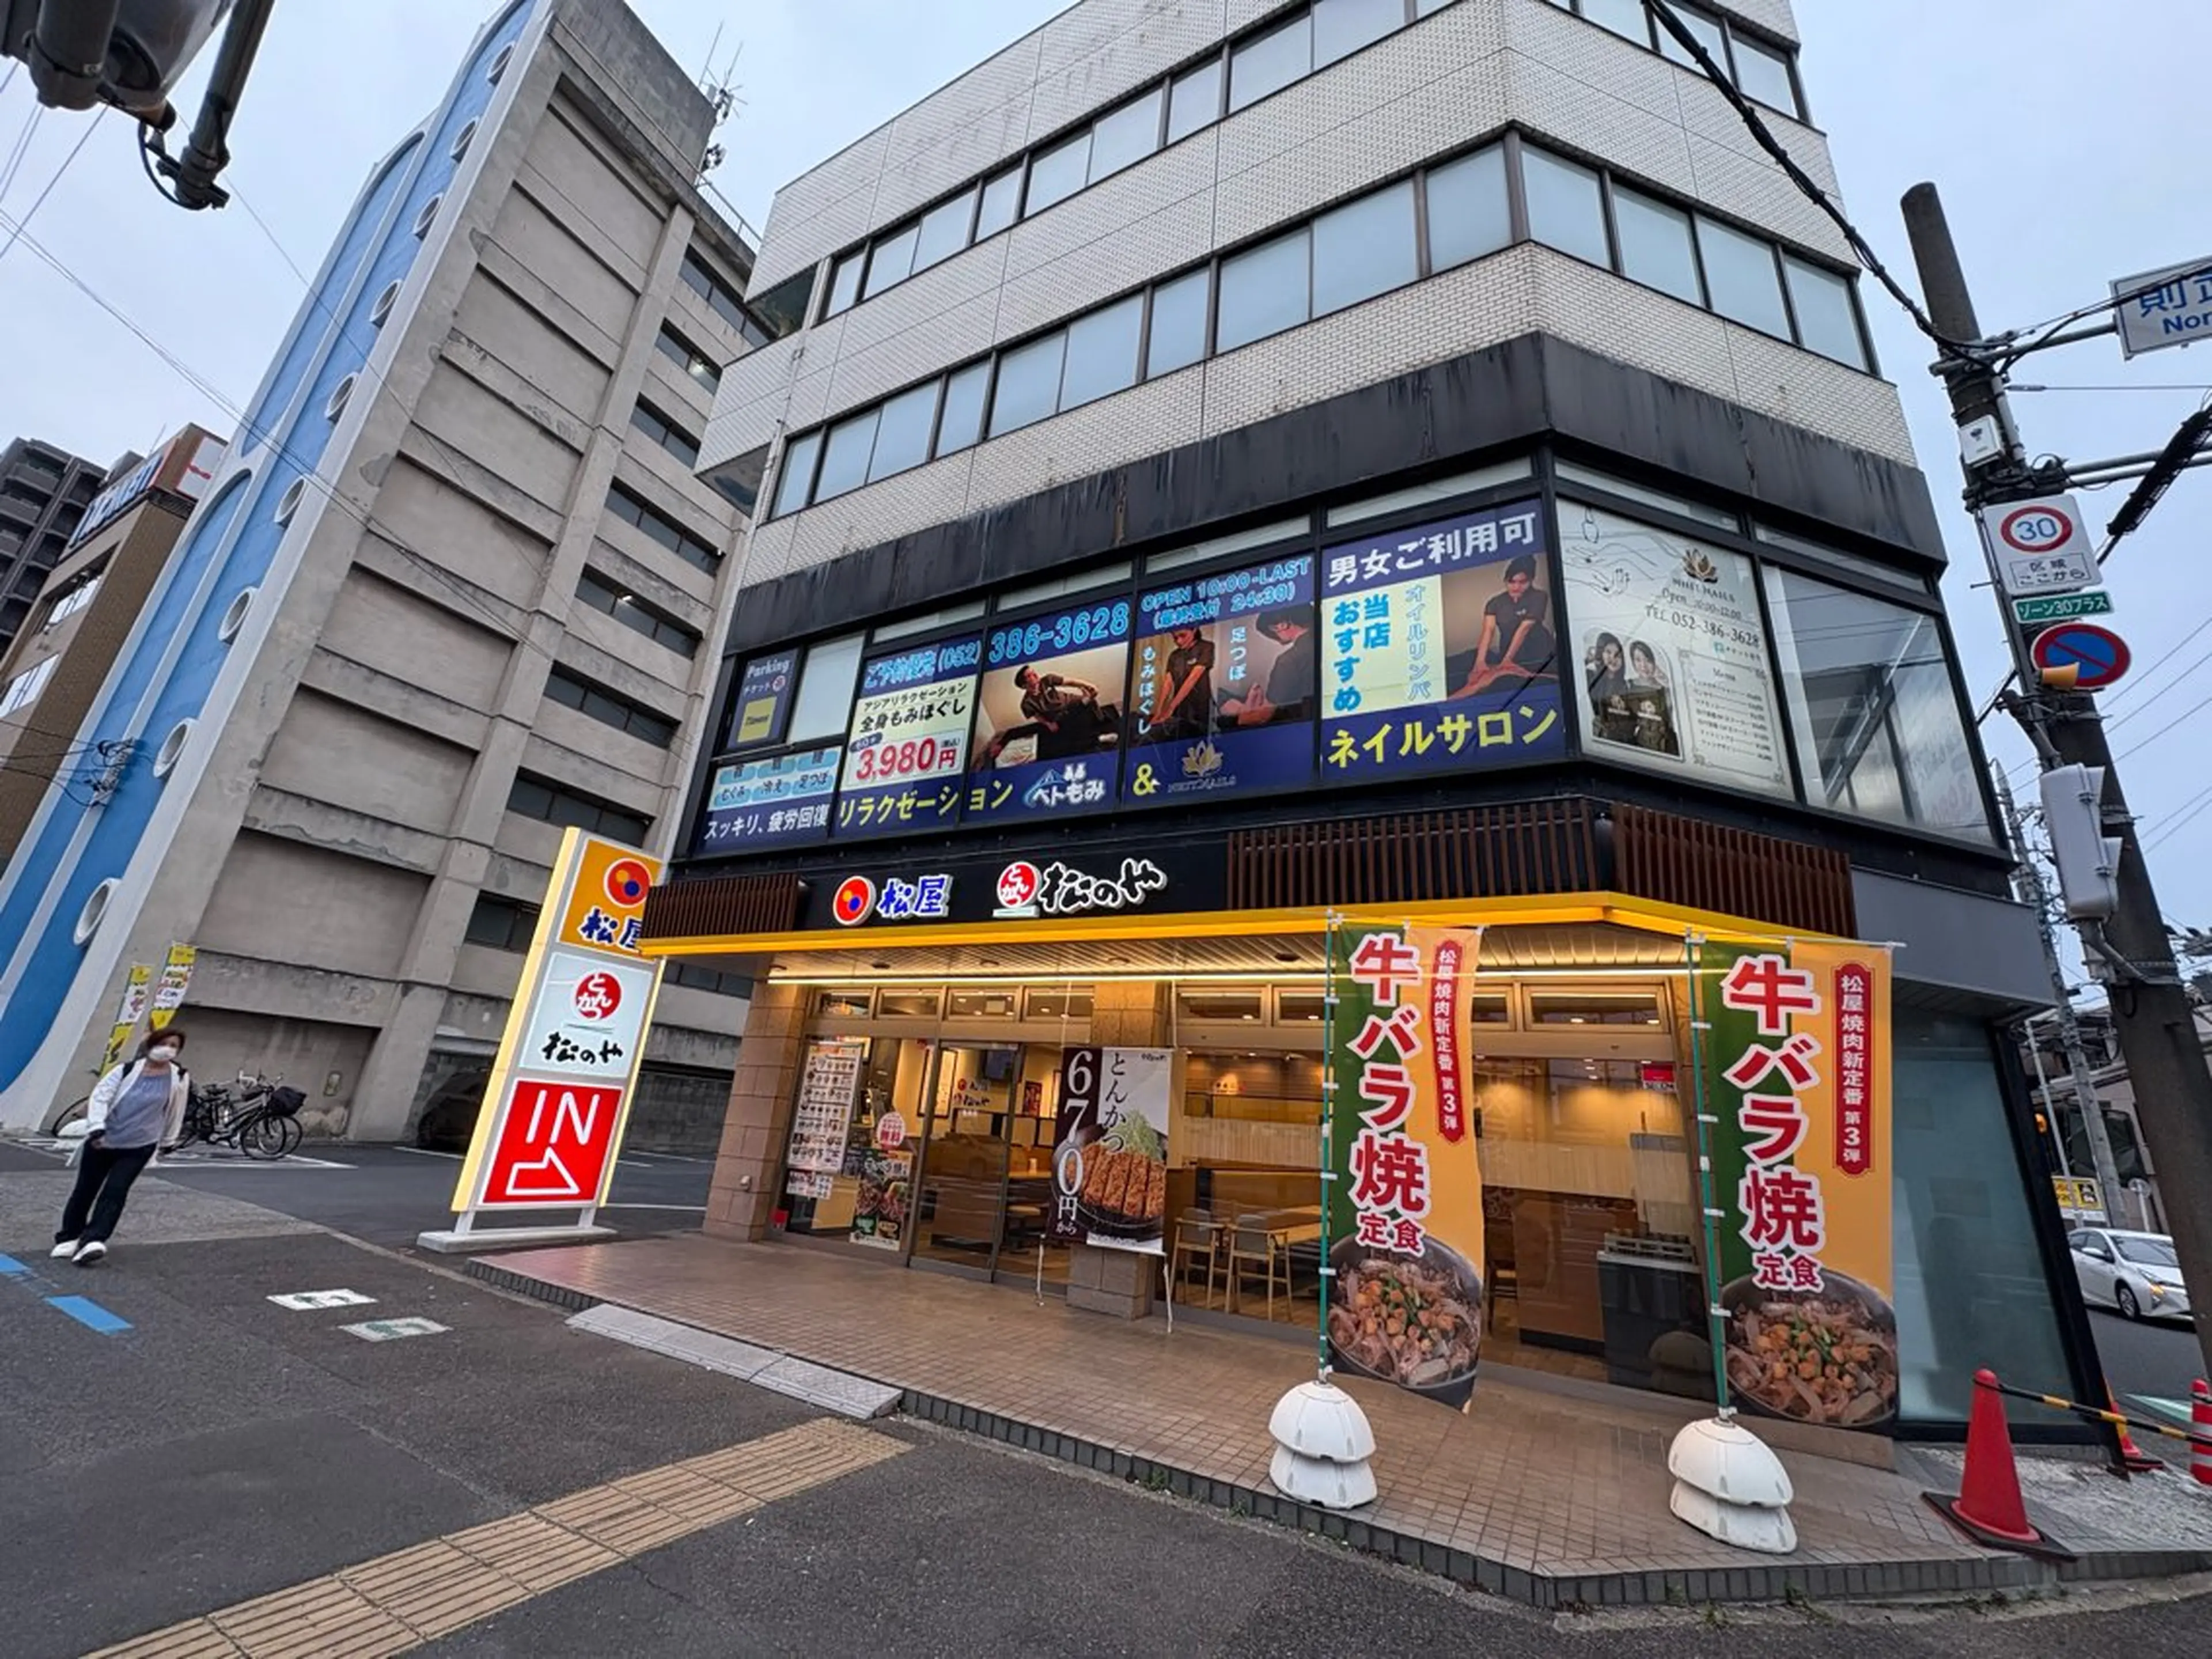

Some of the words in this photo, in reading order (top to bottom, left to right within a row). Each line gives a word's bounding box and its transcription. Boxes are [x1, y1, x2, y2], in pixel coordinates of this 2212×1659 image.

[1328, 512, 1536, 587] 男女ご利用可
[2017, 517, 2058, 540] 30
[1141, 586, 1192, 612] OPEN
[2019, 568, 2085, 585] ここから
[988, 602, 1130, 664] 386-3628
[1362, 593, 1391, 650] 当店
[747, 658, 790, 679] Parking
[1228, 626, 1247, 681] 足つぼ
[1333, 601, 1362, 713] おすすめ
[1138, 646, 1156, 735] もみほぐし
[859, 699, 966, 733] 全身もみほぐし
[1327, 706, 1557, 768] ネイルサロン
[839, 779, 1014, 828] リラクゼーション
[1032, 779, 1105, 806] ベトもみ
[1132, 763, 1154, 796] &
[877, 873, 950, 918] 松屋
[1037, 857, 1167, 914] 松のや
[577, 971, 613, 1020] とんかつ
[542, 1032, 624, 1065] 松のや
[1351, 934, 1427, 1217] 牛バラ焼
[525, 1089, 601, 1145] IN
[1102, 1052, 1128, 1153] とんかつ
[1726, 957, 1822, 1250] 牛バラ焼
[1358, 1211, 1424, 1255] 定食
[1755, 1253, 1822, 1289] 定食
